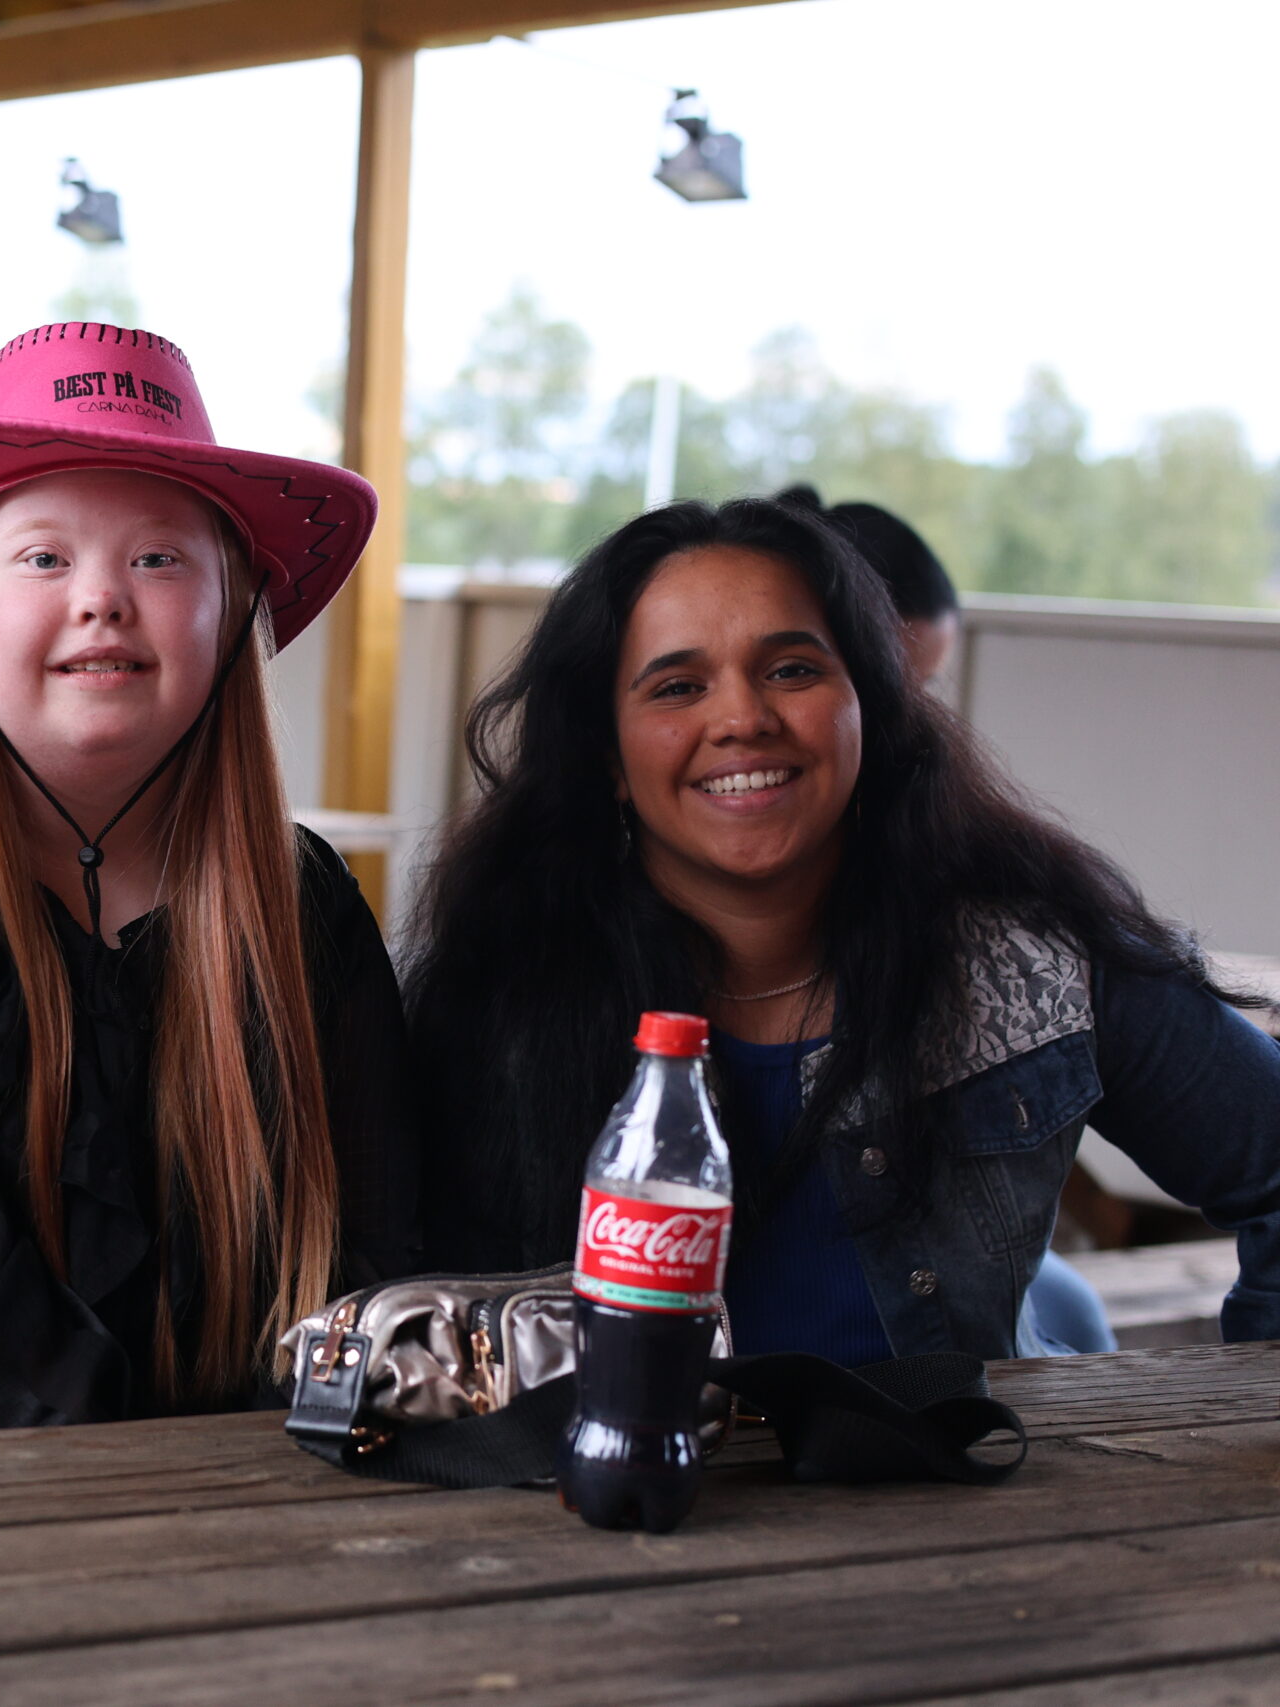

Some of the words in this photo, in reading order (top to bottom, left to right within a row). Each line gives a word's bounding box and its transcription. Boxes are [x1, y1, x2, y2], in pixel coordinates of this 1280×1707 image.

[53, 372, 106, 402] BÆST
[113, 371, 138, 400] PÅ
[141, 379, 182, 420] FÆST
[77, 401, 133, 414] CARINA
[136, 404, 172, 426] DAHL
